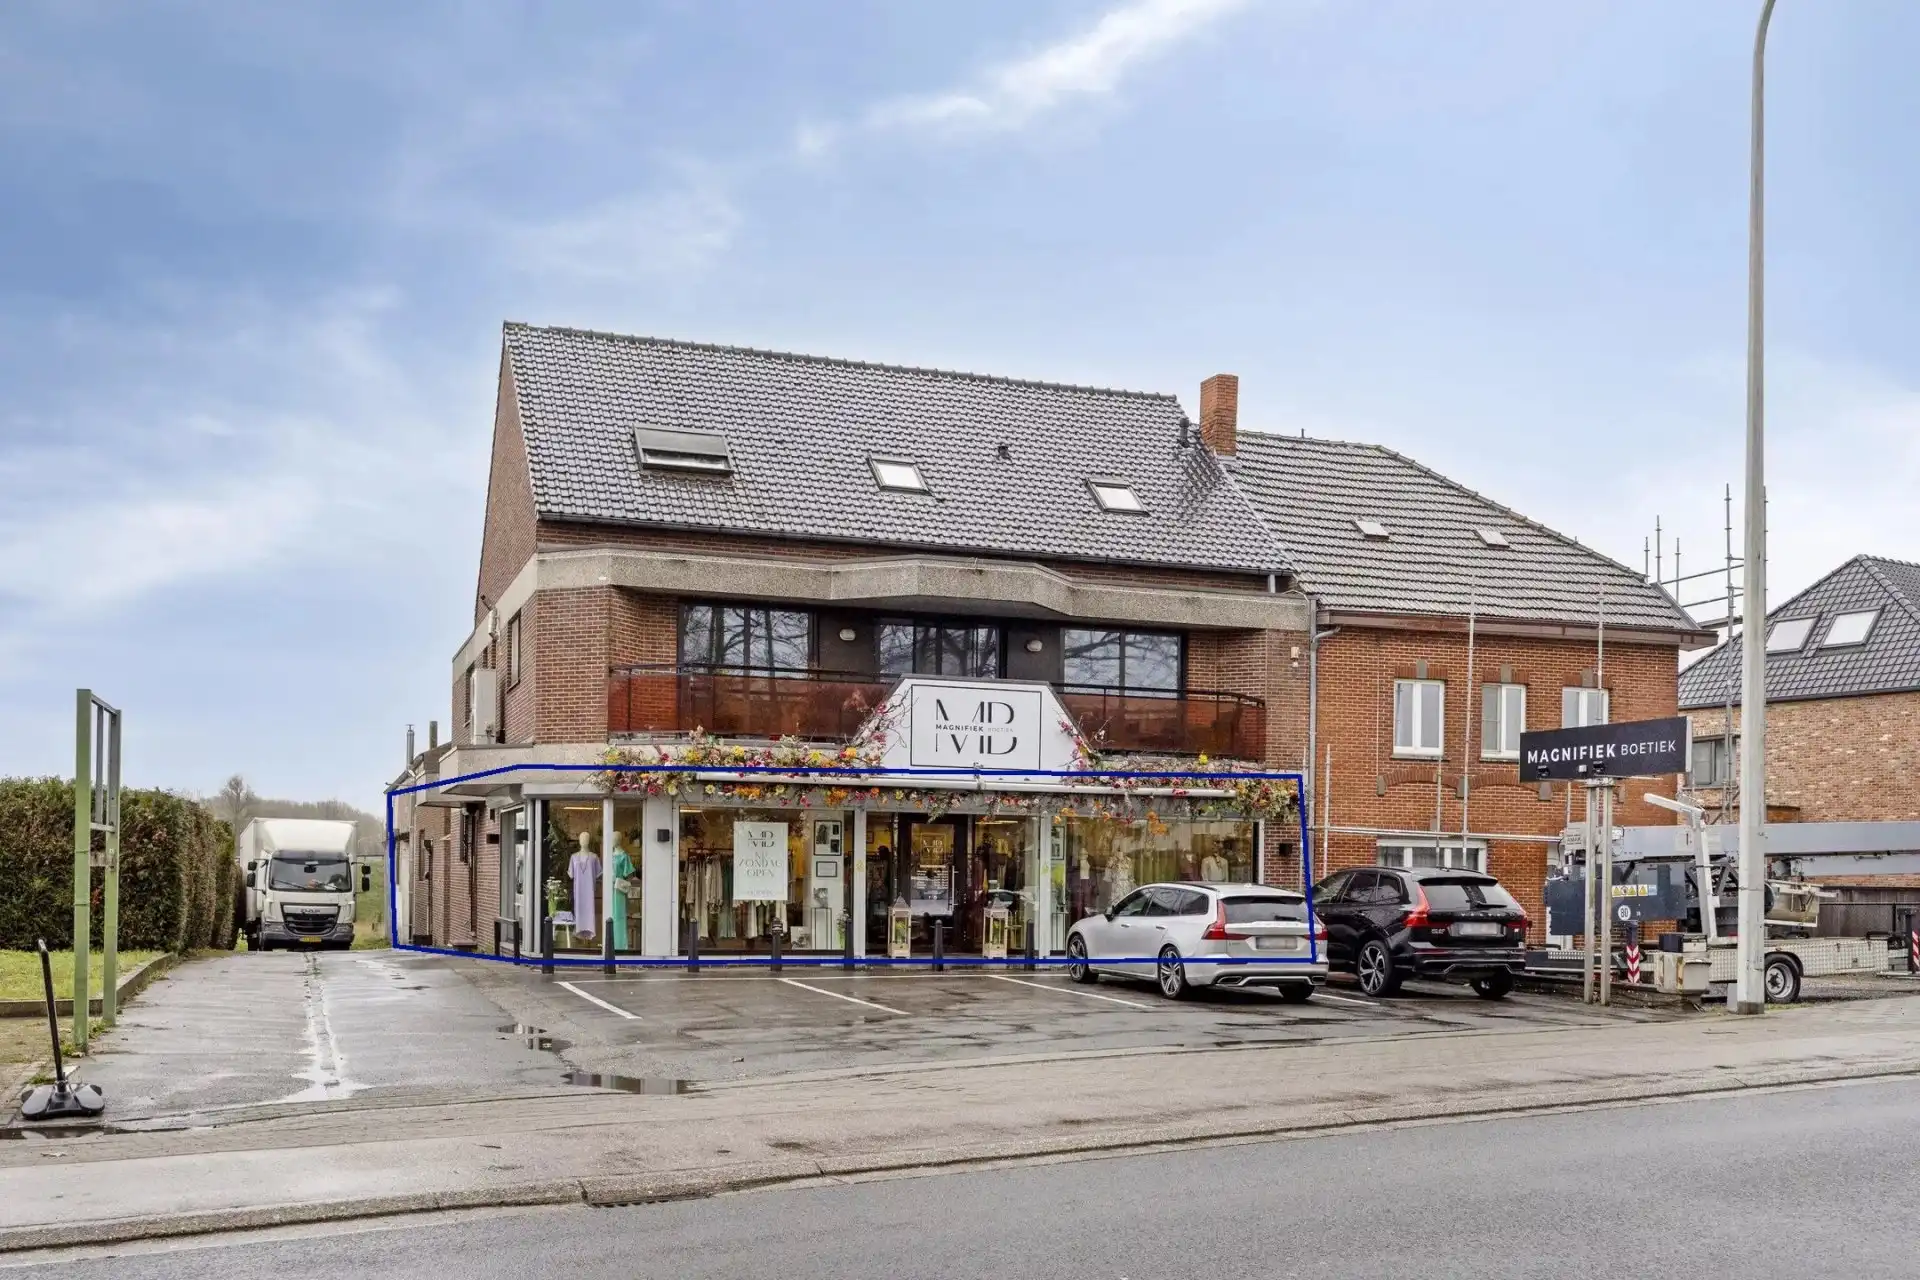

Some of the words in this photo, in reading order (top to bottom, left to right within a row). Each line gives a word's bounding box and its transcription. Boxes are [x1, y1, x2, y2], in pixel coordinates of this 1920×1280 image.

[936, 724, 984, 732] MAGNIFIEK
[1527, 743, 1616, 764] MAGNIFIEK
[1621, 740, 1676, 755] BOETIEK
[1620, 907, 1629, 918] 80
